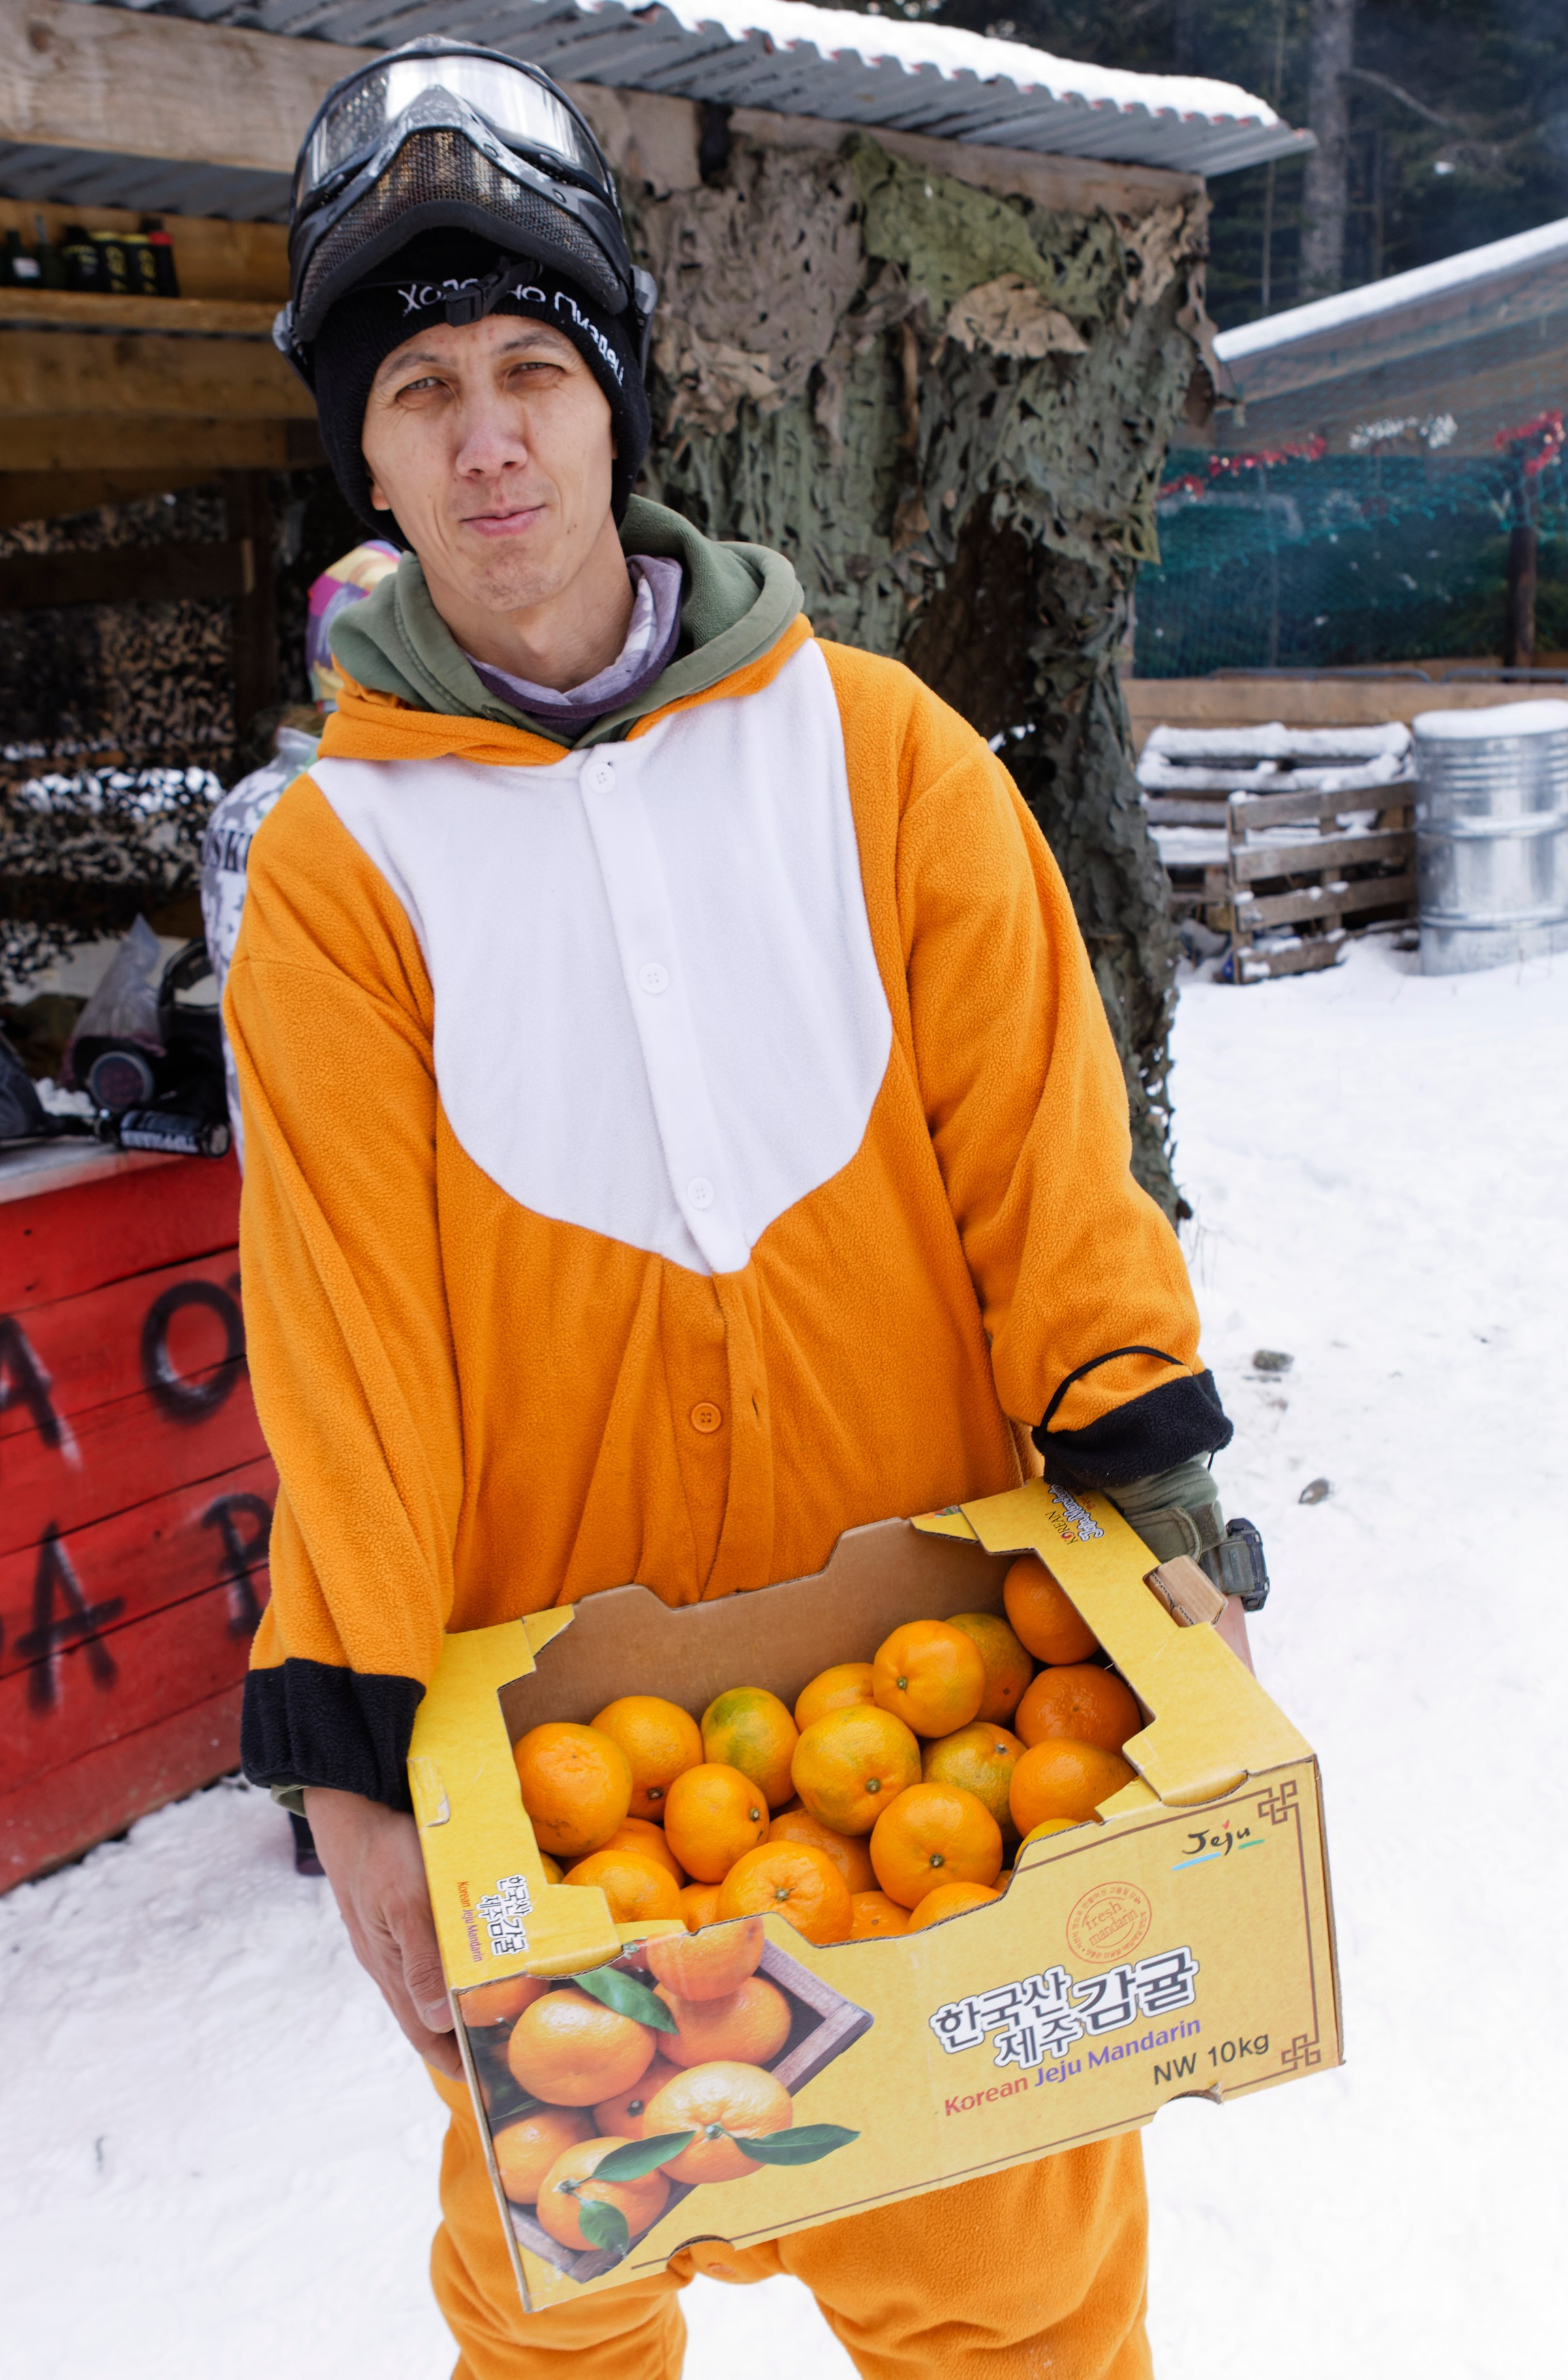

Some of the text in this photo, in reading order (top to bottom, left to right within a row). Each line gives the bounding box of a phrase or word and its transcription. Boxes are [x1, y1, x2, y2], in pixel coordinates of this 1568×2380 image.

[397, 279, 546, 318] Хоно
[1045, 1510, 1079, 1546] KOREAN
[1182, 1822, 1251, 1856] Jeju
[498, 1874, 532, 1917] 한국산
[1084, 1901, 1123, 1931] fresh
[457, 1881, 485, 1962] Korean Jeju Mandarin
[1088, 1909, 1139, 1947] mandarin
[933, 1966, 1070, 2051] 한국산
[944, 2019, 1201, 2117] Korean Jeju Mandarin
[1153, 2033, 1270, 2086] NW 10kg
